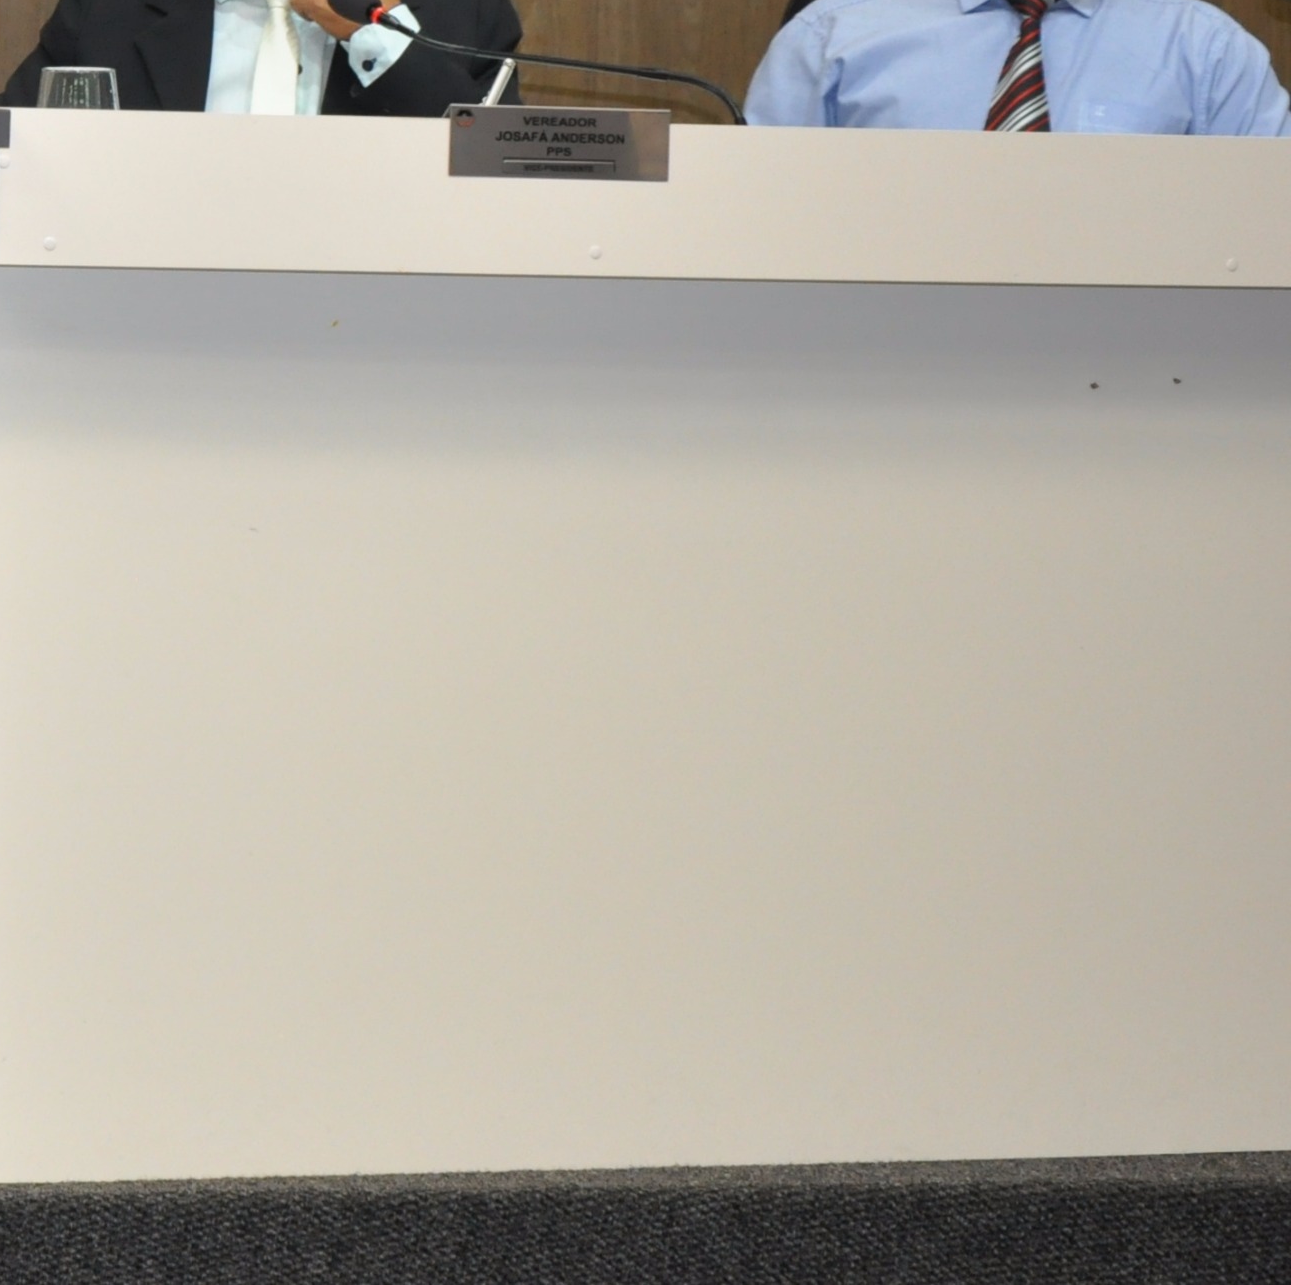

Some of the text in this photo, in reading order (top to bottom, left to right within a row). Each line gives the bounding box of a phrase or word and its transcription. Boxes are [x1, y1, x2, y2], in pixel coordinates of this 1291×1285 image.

[523, 116, 597, 128] VEREADOR
[551, 132, 626, 145] ANDERSON
[546, 146, 572, 157] PPS
